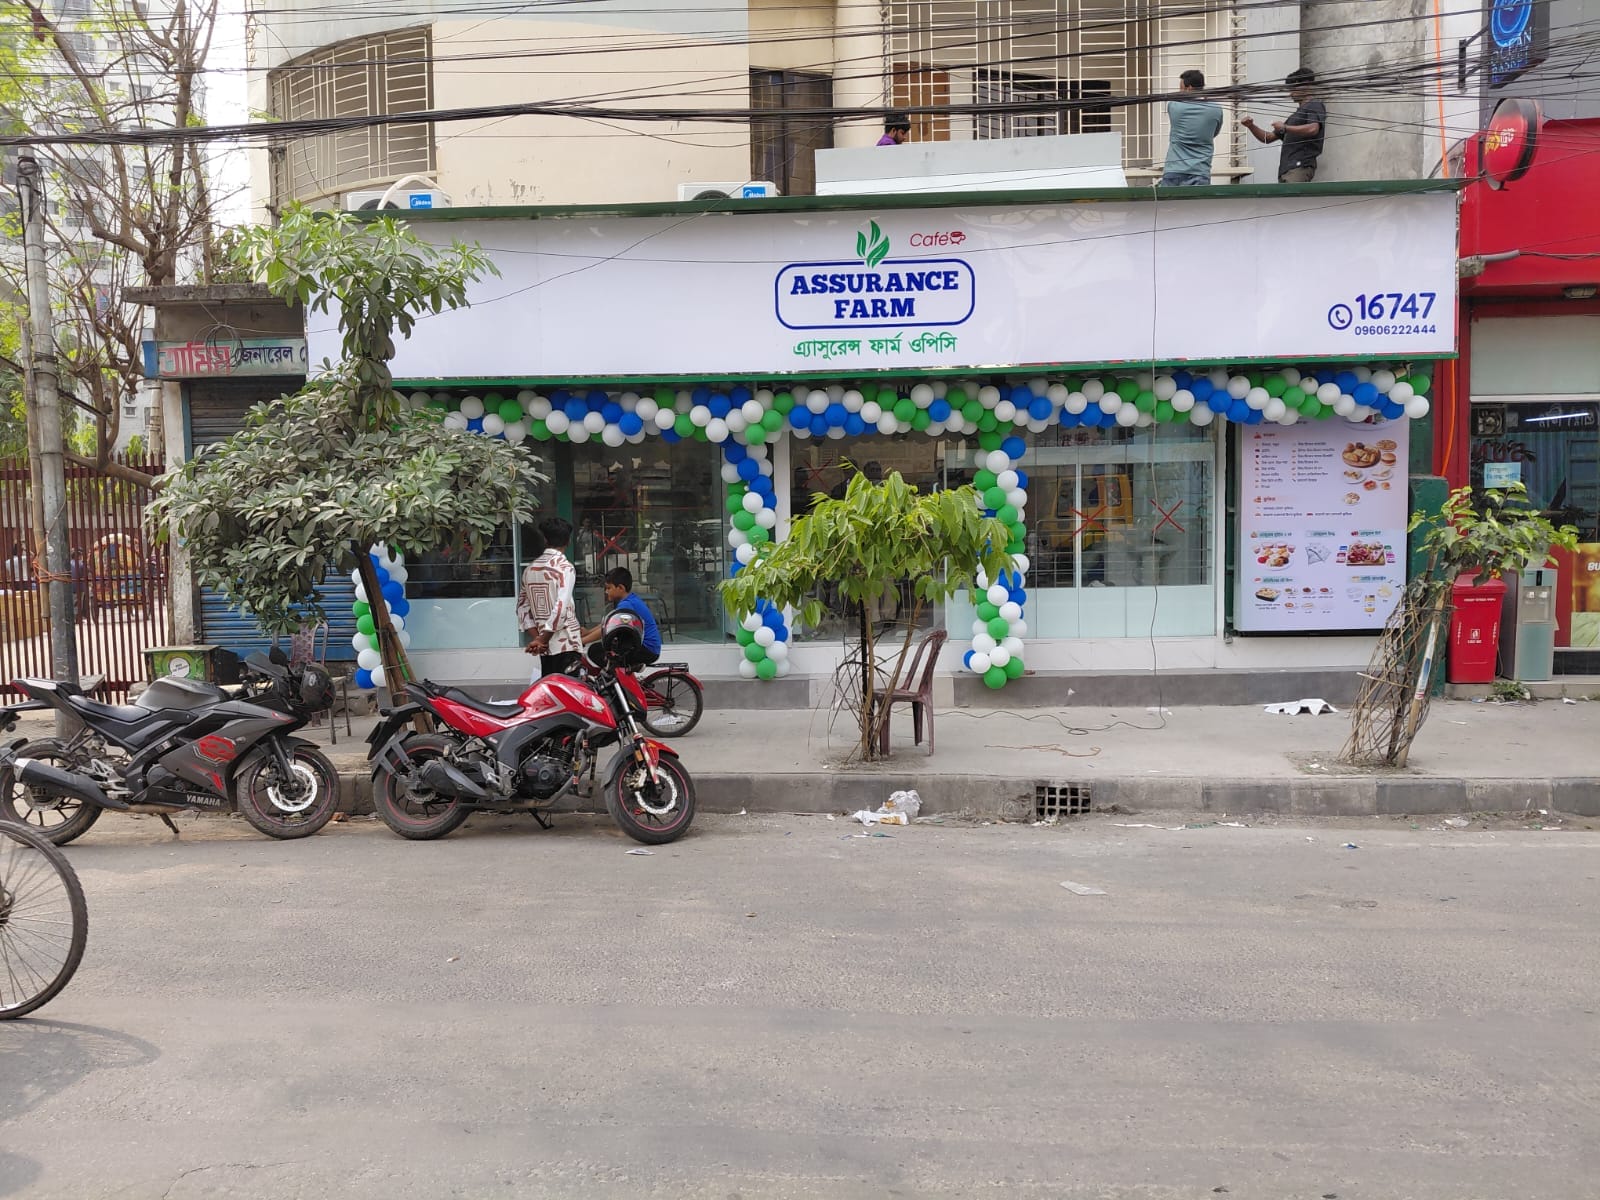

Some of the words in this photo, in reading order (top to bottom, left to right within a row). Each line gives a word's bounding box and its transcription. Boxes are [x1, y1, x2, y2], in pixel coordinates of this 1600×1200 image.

[910, 231, 949, 247] Café
[790, 270, 959, 295] ASSURANCE
[834, 298, 915, 319] FARM
[1355, 292, 1437, 320] 16747
[1354, 324, 1437, 336] 09606222444
[868, 331, 903, 355] ফার্ম
[908, 331, 958, 354] ওপিসি
[186, 794, 221, 807] YAMAHA
